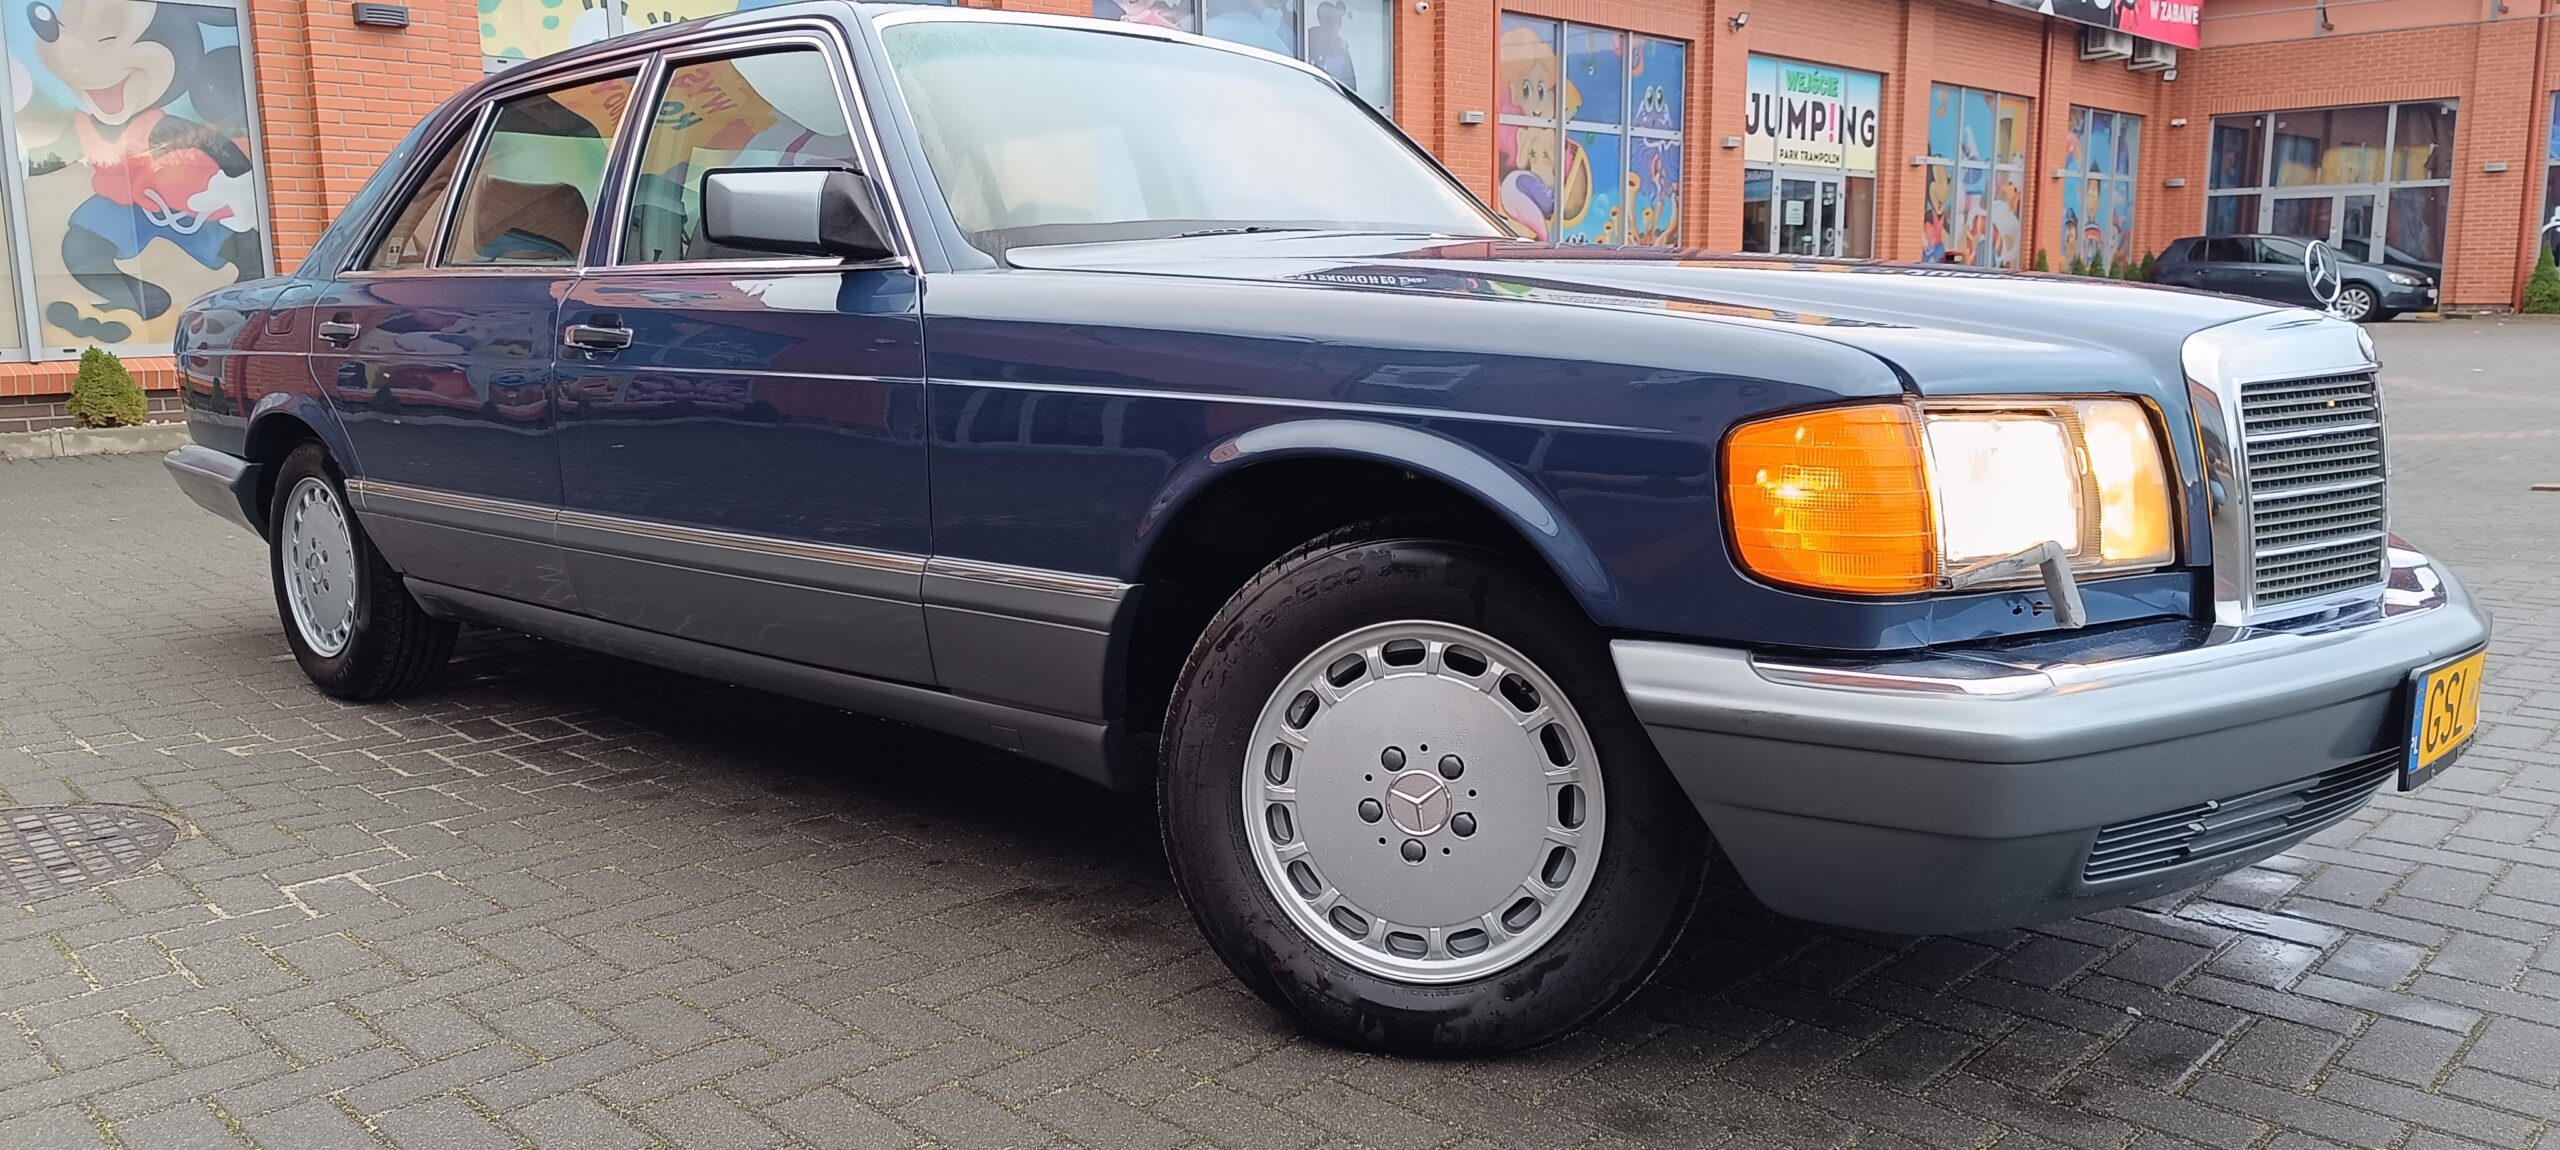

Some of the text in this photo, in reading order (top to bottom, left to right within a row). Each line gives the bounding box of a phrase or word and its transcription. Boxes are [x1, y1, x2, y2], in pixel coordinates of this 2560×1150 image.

[1786, 69, 1839, 98] WEJŚCIE
[1745, 92, 1876, 148] JUMP!NG
[1779, 148, 1840, 164] PARK TRAMPOLIN
[2426, 668, 2468, 753] GSL
